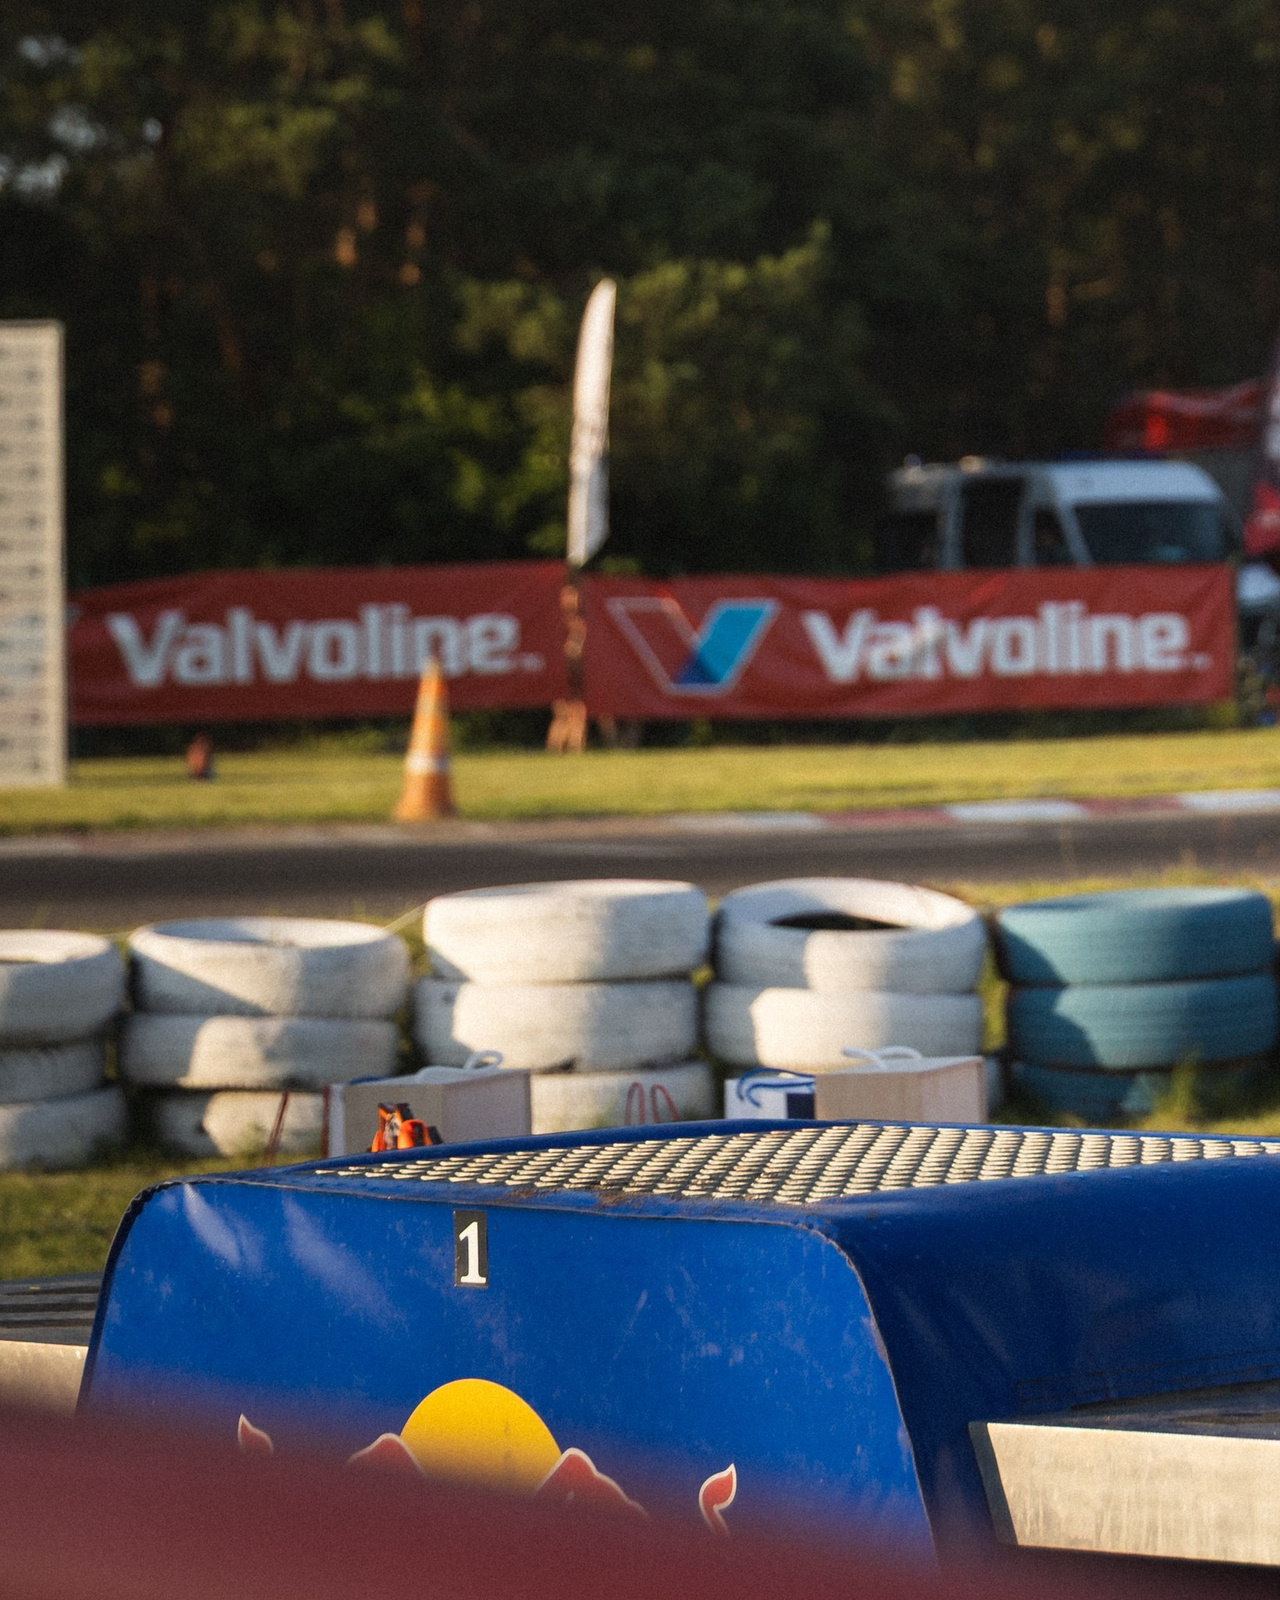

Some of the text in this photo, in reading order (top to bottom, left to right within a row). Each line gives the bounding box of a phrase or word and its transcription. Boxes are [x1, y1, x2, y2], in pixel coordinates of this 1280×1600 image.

[107, 603, 519, 688] Valvoline
[803, 600, 1192, 684] Valvoline
[458, 1221, 488, 1285] 1
